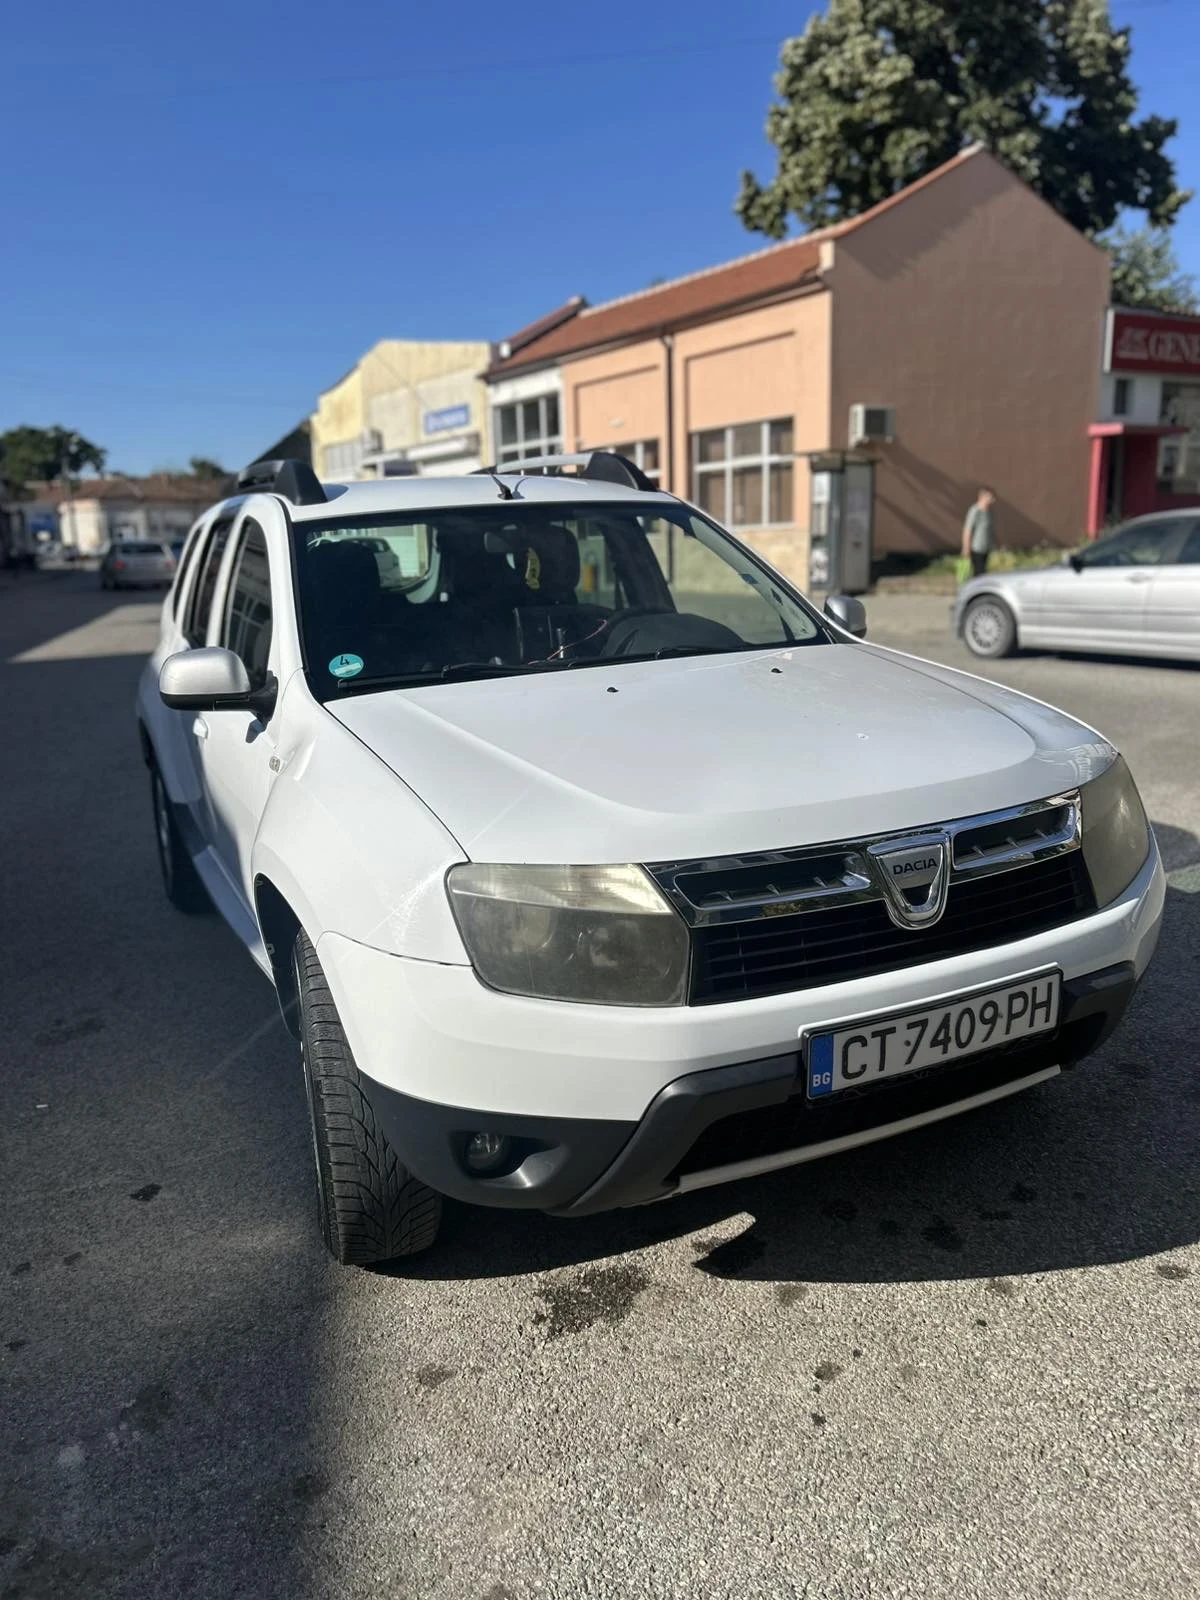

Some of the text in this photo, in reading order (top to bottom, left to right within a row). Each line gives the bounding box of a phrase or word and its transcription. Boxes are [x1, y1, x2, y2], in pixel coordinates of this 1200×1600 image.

[340, 655, 350, 666] 4
[893, 858, 937, 875] DACIA
[905, 1000, 999, 1065] 7409
[812, 1072, 832, 1088] BG
